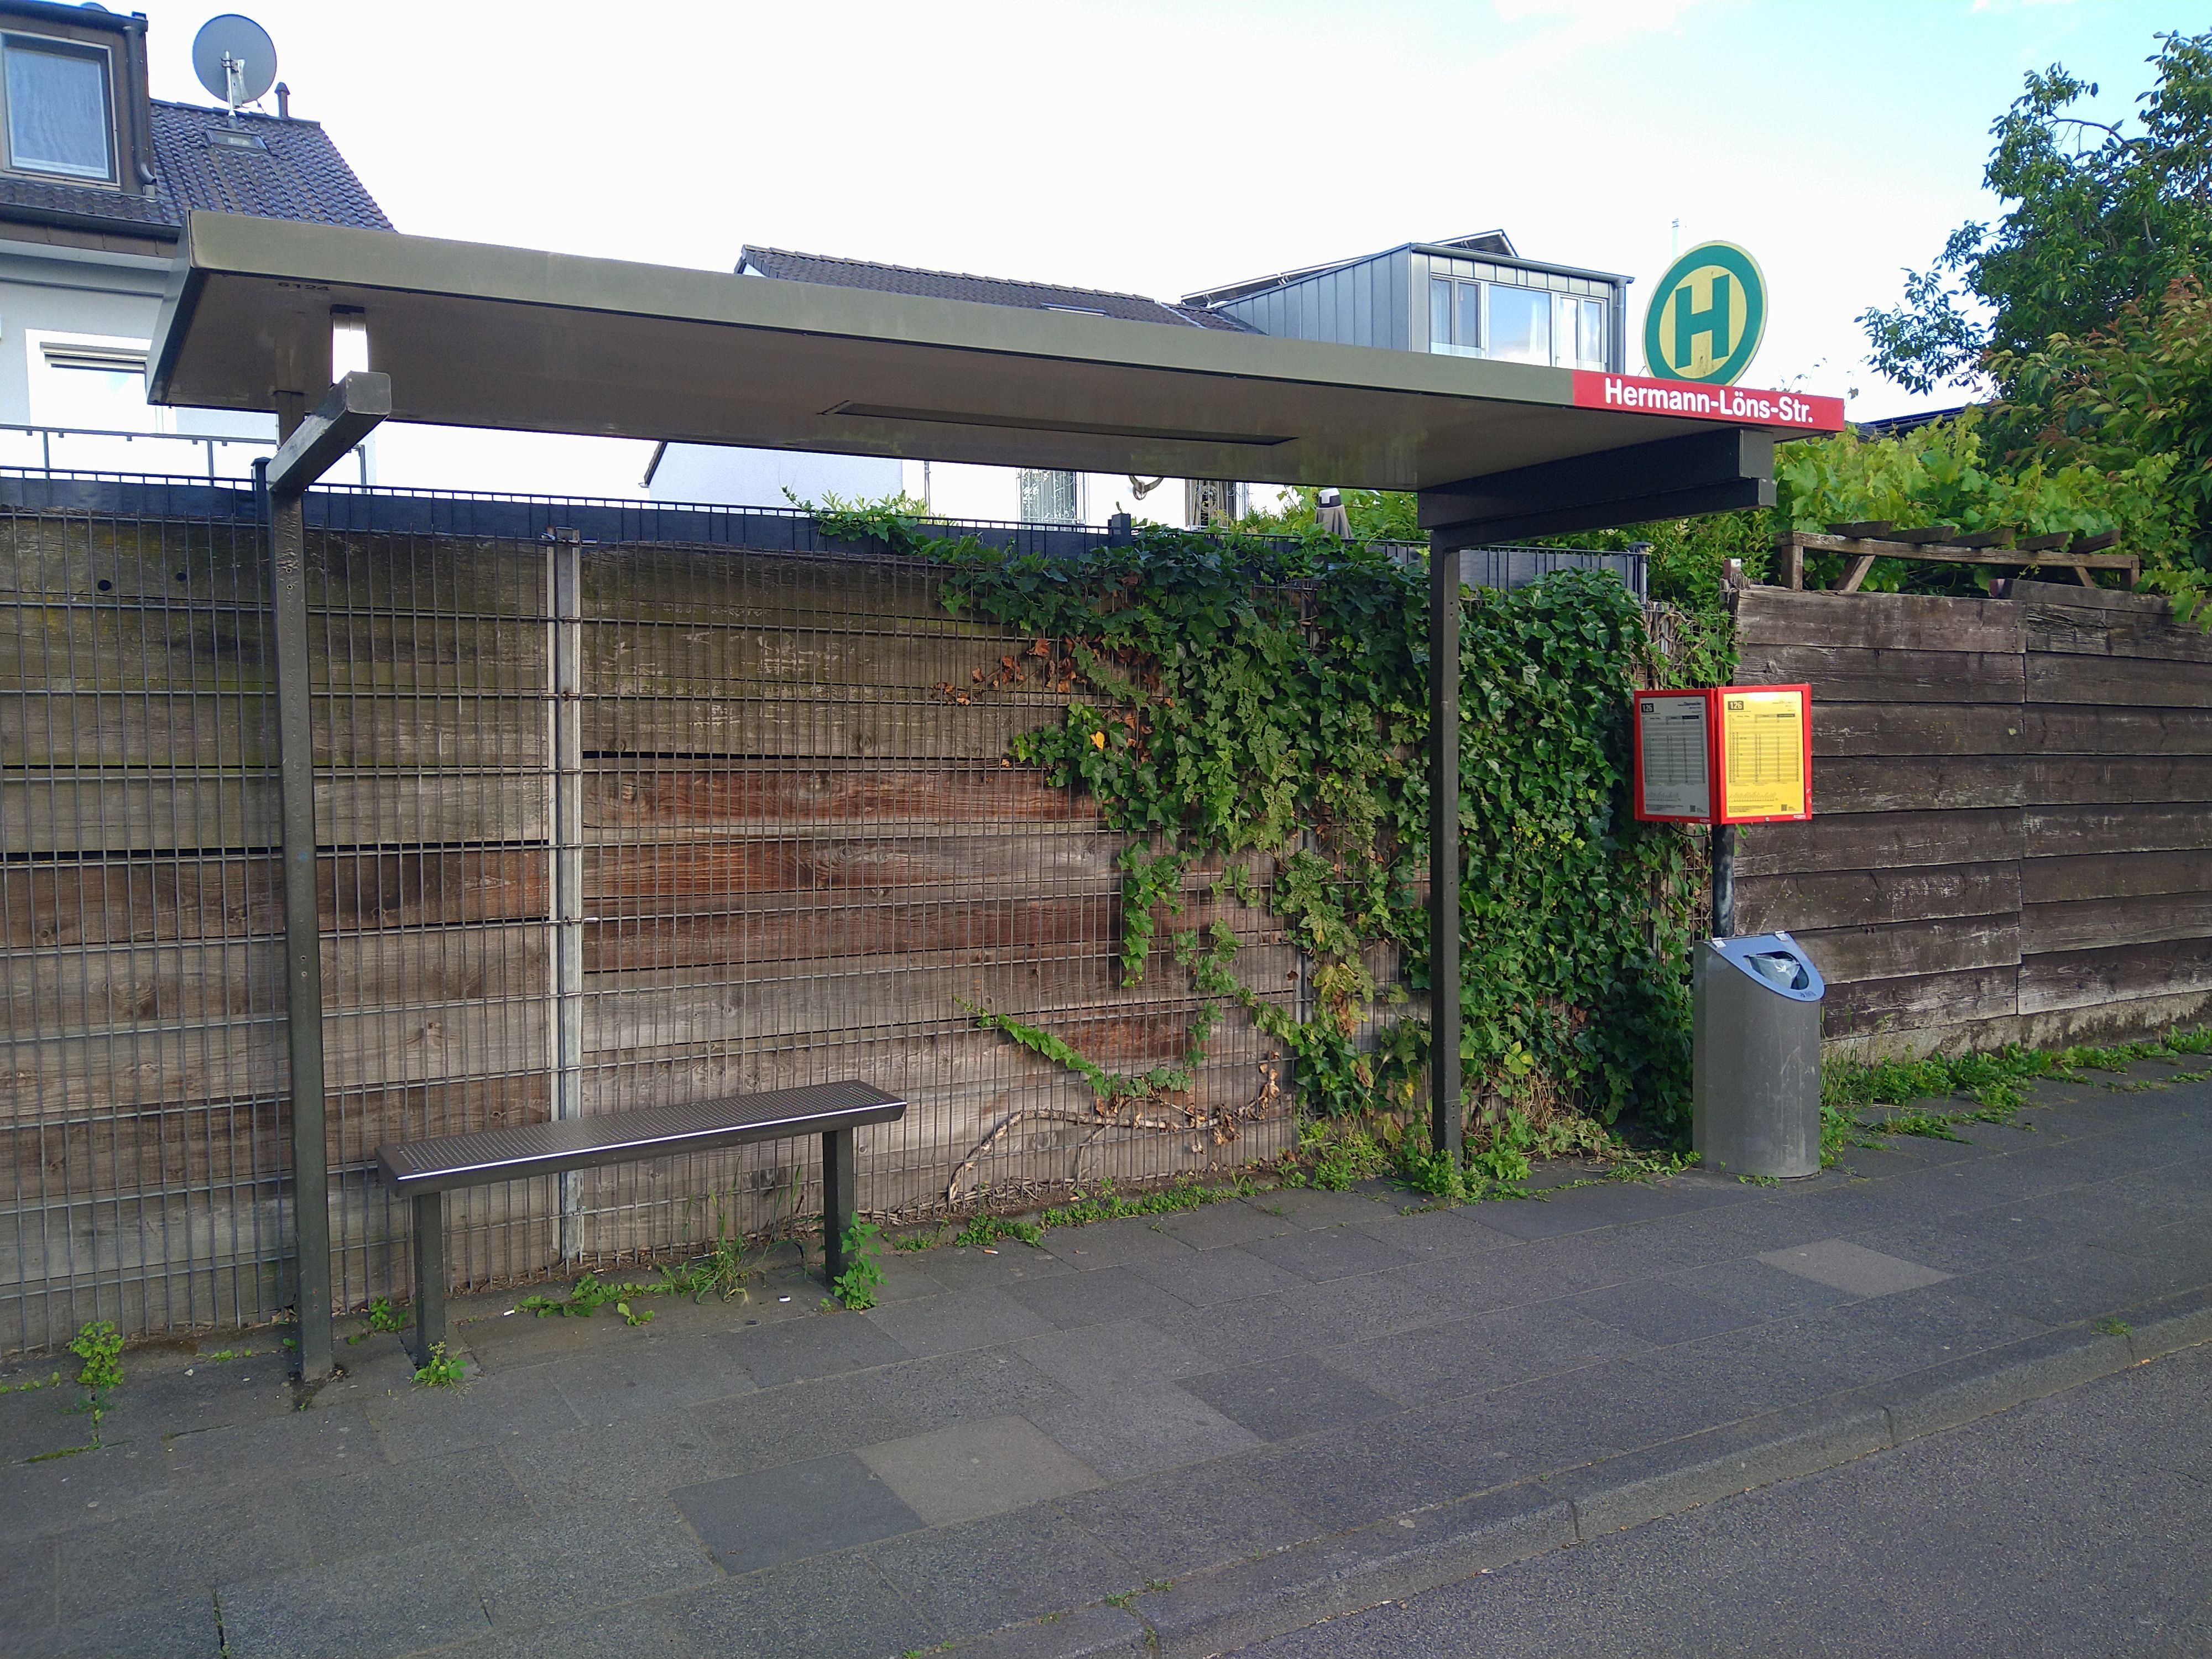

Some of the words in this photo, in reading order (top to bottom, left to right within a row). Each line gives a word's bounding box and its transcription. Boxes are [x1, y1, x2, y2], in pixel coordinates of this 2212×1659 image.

[278, 282, 330, 291] 6124
[1675, 274, 1729, 369] H
[1605, 377, 1813, 423] Hermann-Löns-Str.
